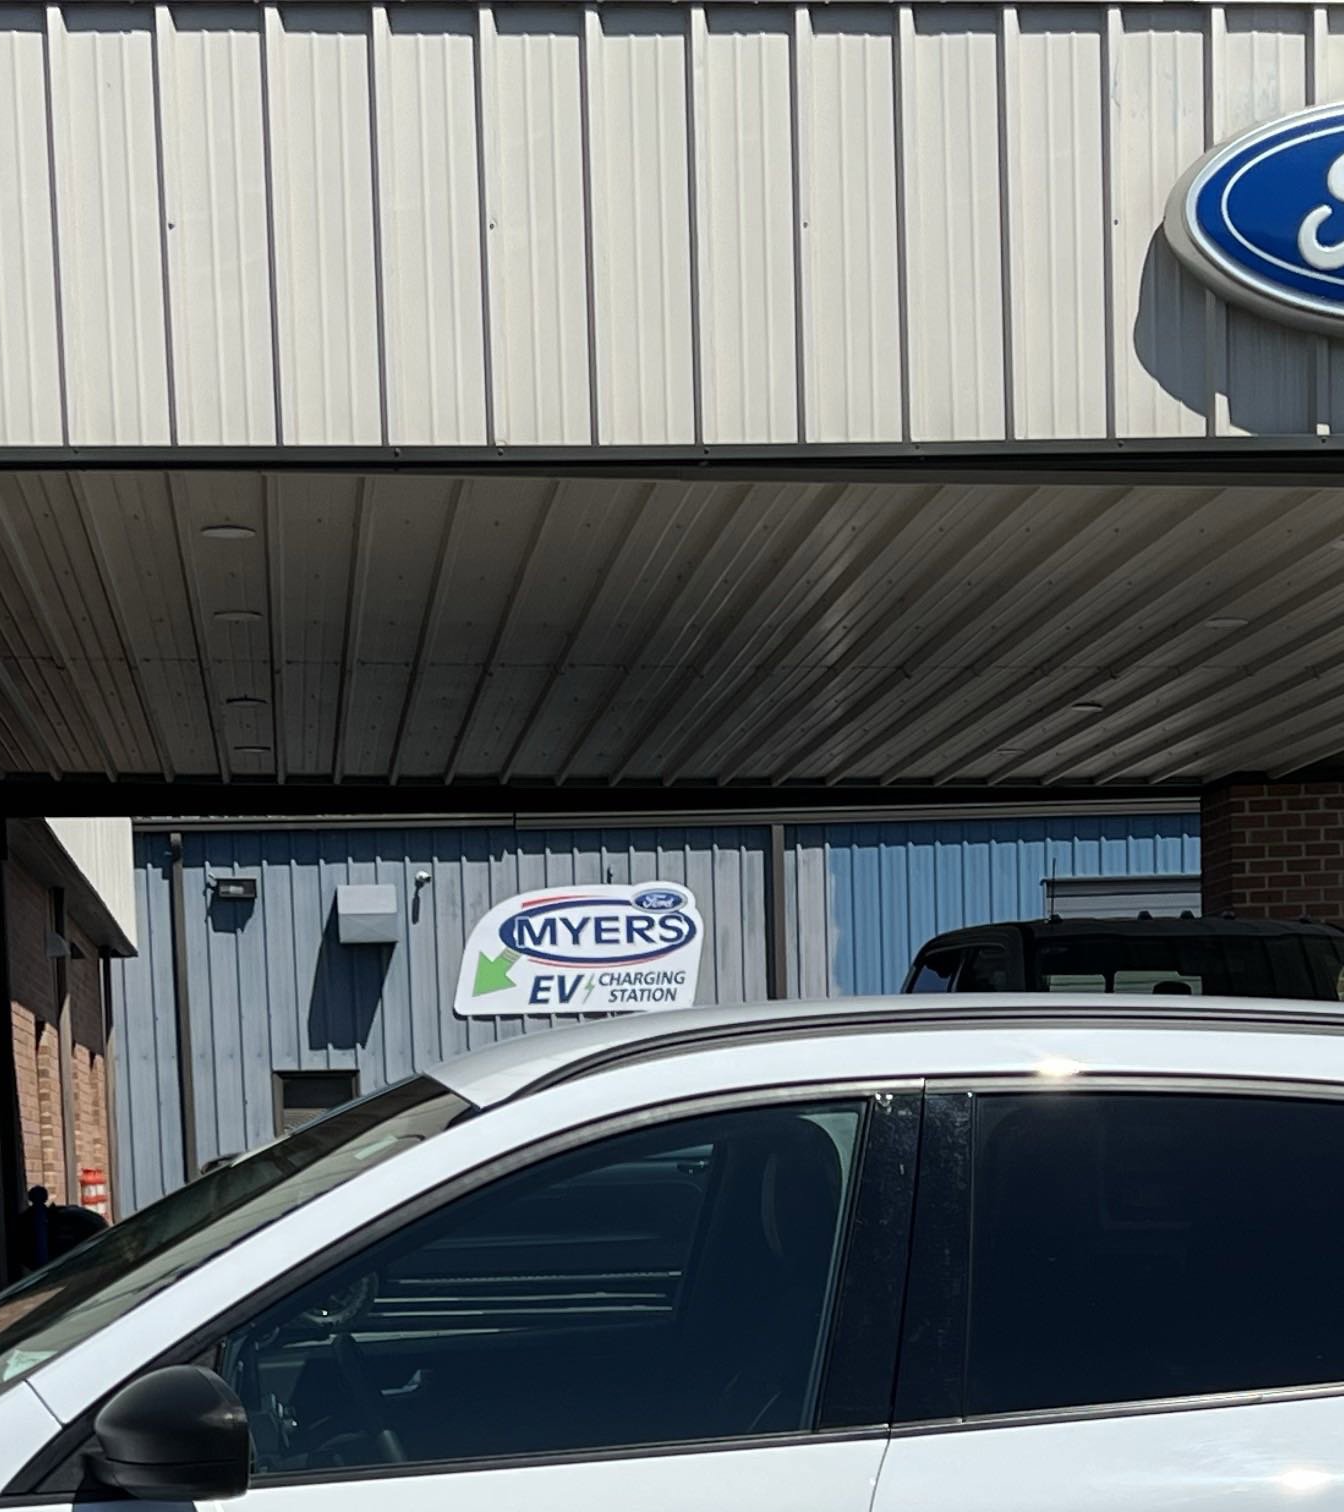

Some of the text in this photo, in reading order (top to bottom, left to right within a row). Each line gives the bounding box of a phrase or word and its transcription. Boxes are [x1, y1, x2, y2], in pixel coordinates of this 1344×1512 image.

[642, 894, 674, 909] Ford
[516, 914, 684, 946] MYERS
[598, 970, 686, 987] CHARGING
[528, 974, 585, 1005] EV
[608, 987, 677, 1003] STATION
